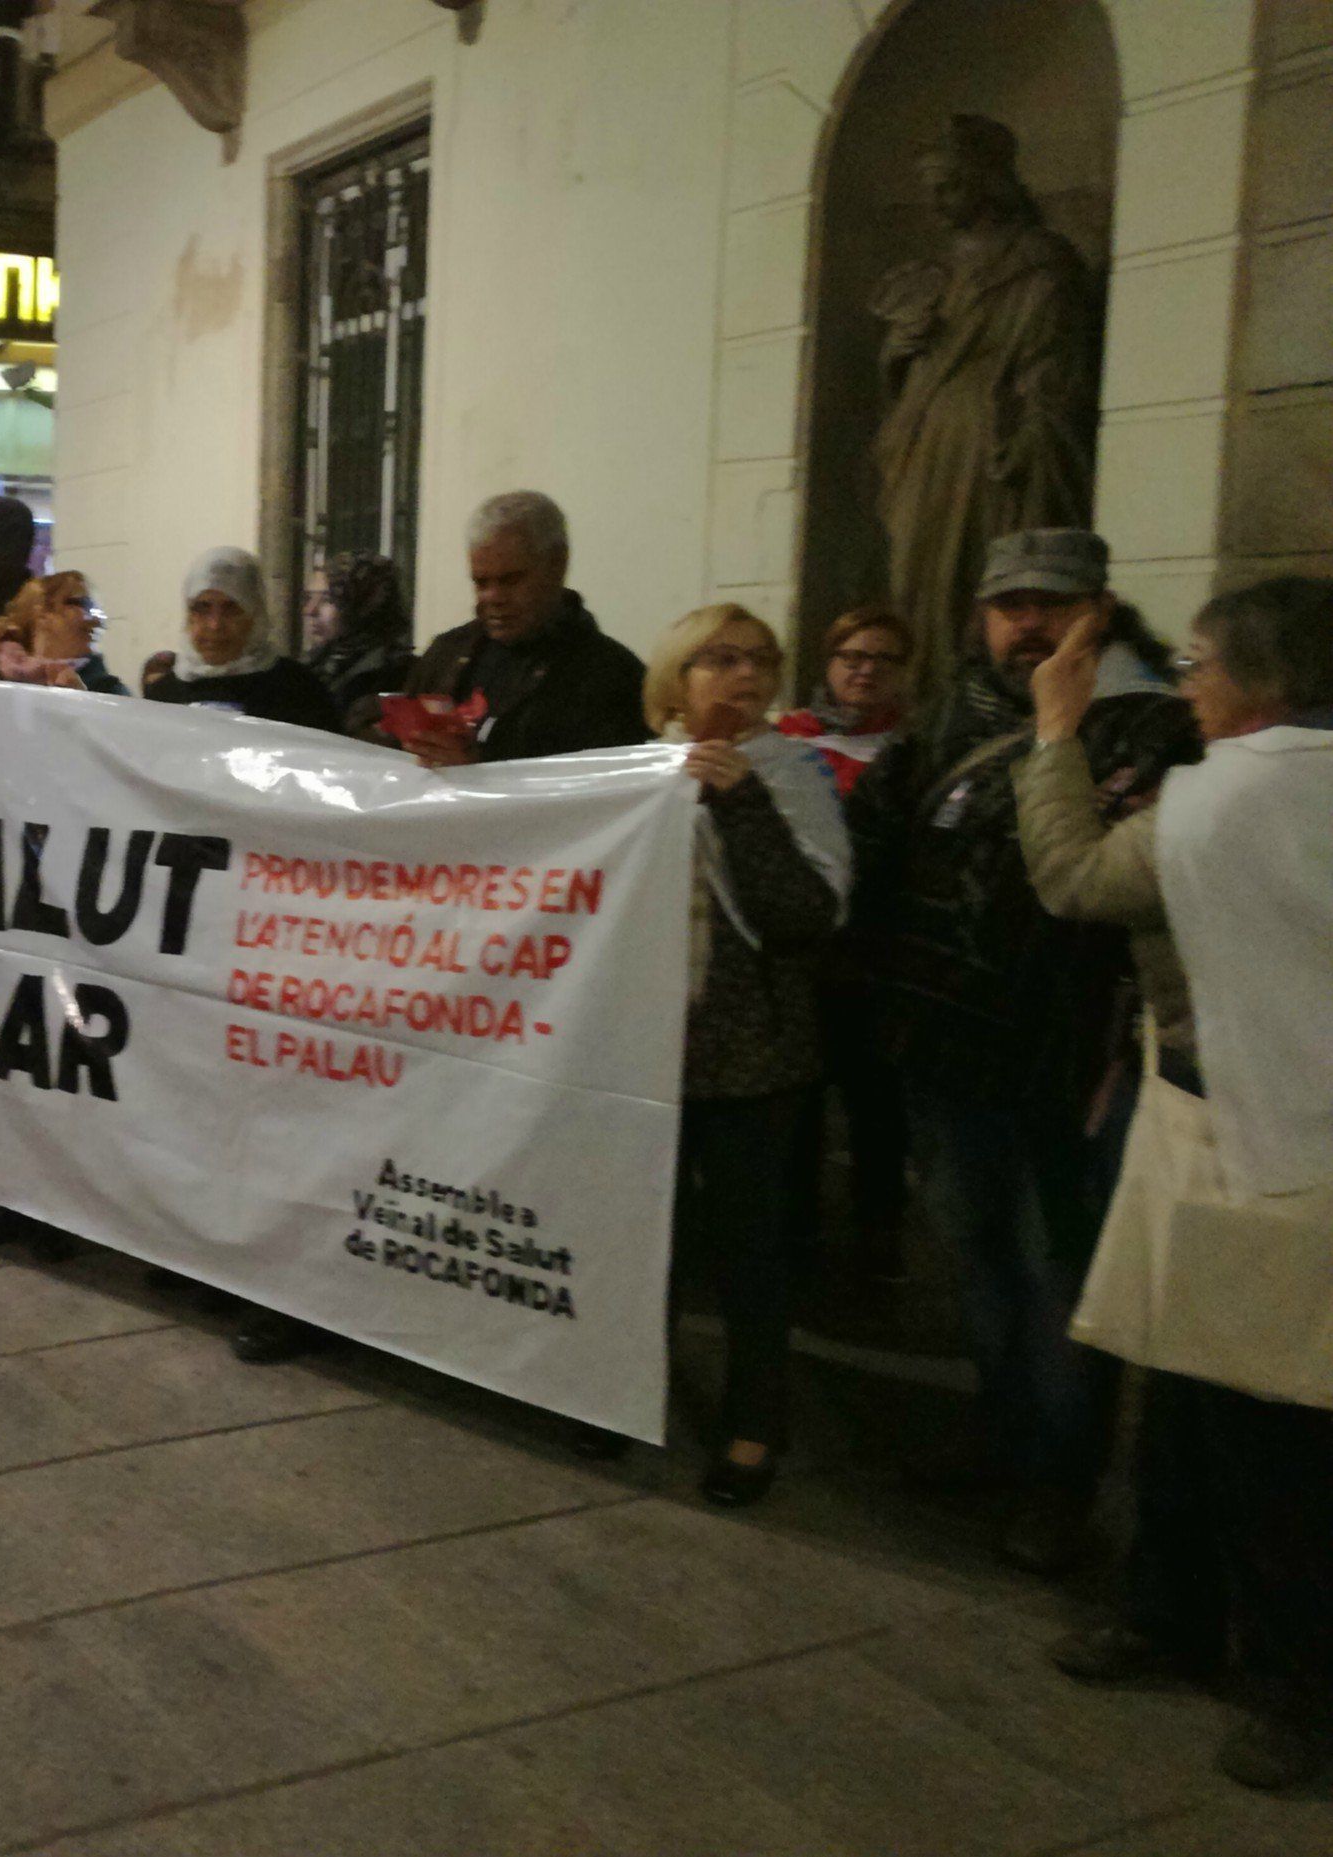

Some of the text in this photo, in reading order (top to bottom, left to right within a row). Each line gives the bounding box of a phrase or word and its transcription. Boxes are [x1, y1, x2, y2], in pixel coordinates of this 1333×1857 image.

[239, 851, 605, 915] PROU DEMORES EN
[236, 911, 573, 980] L'ATENCIÓ AL CAP
[227, 968, 276, 1013] DE
[278, 975, 526, 1043] ROCAFONDA
[226, 1024, 406, 1087] EL PALAU
[376, 1158, 538, 1228] Assemblea
[343, 1229, 577, 1320] de ROCAFONDA
[442, 1217, 480, 1251] de
[486, 1228, 573, 1276] Salut
